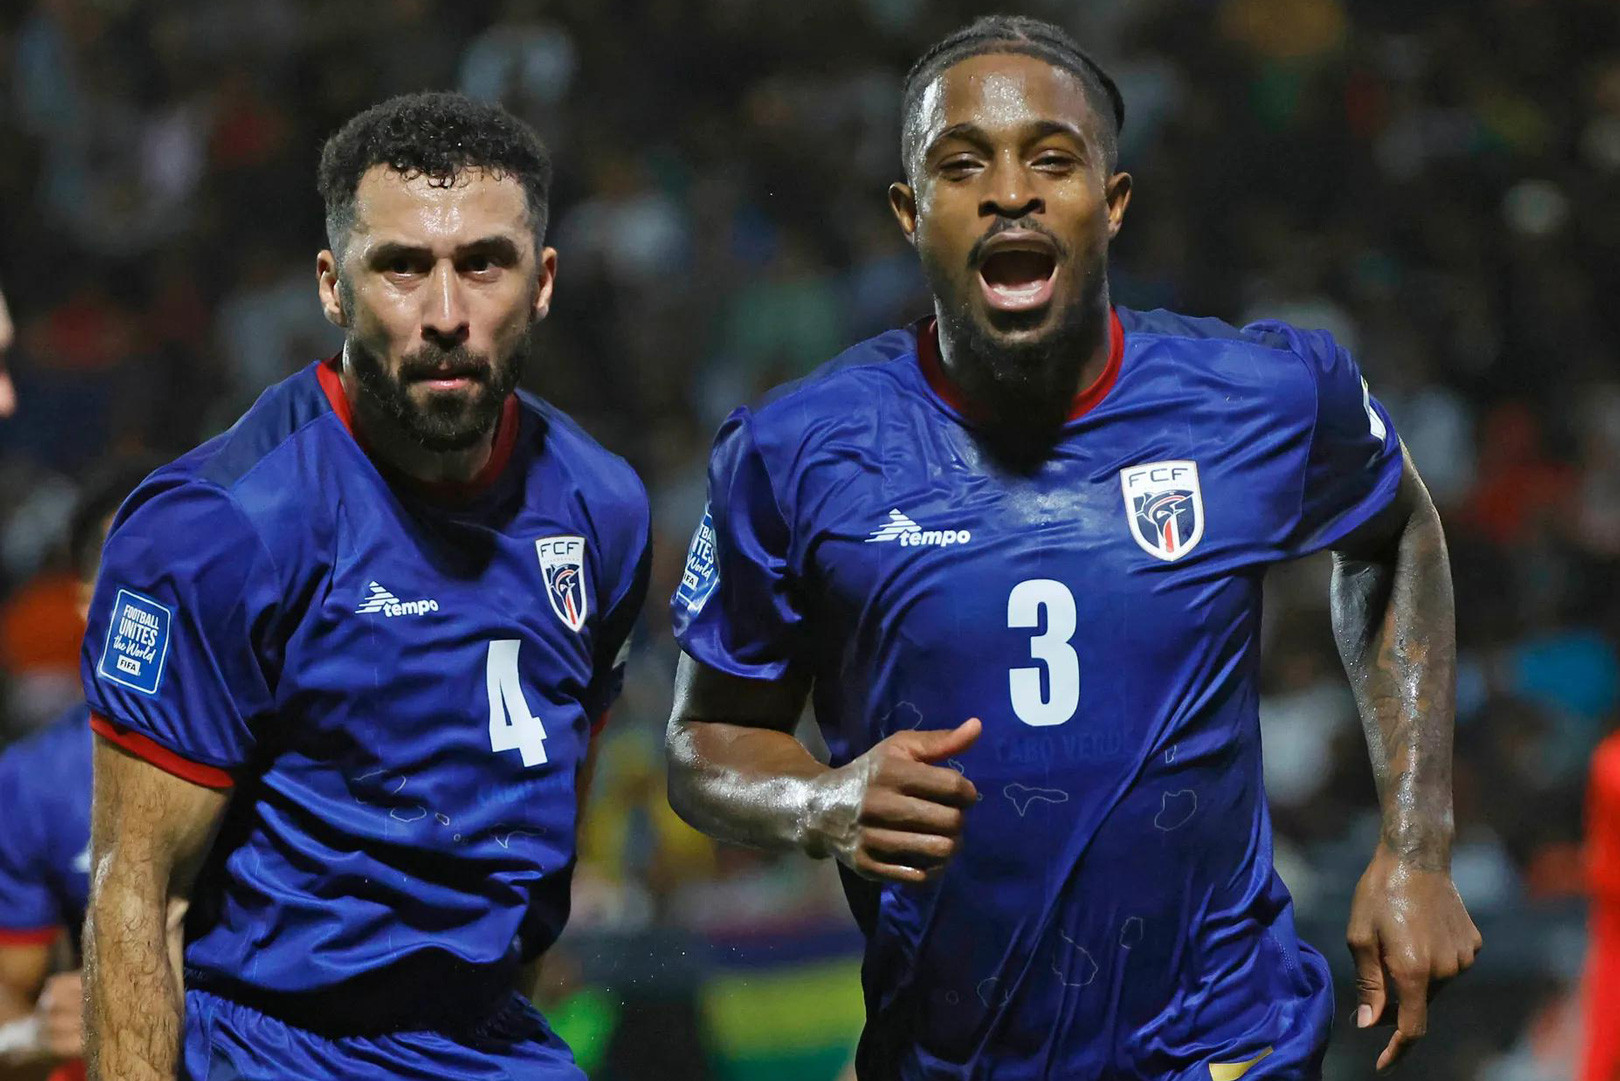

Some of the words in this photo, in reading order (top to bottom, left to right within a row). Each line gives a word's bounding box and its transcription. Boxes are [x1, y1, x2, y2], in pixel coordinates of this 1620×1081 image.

[1128, 467, 1188, 488] FCF
[540, 541, 580, 558] FCF
[899, 529, 971, 547] tempo
[124, 604, 159, 630] FOOTBALL
[383, 599, 439, 617] tempo
[119, 617, 158, 647] UNITES
[113, 635, 127, 651] the
[126, 640, 156, 664] World
[1008, 579, 1080, 727] 3
[119, 659, 137, 672] FIFA
[486, 639, 548, 768] 4
